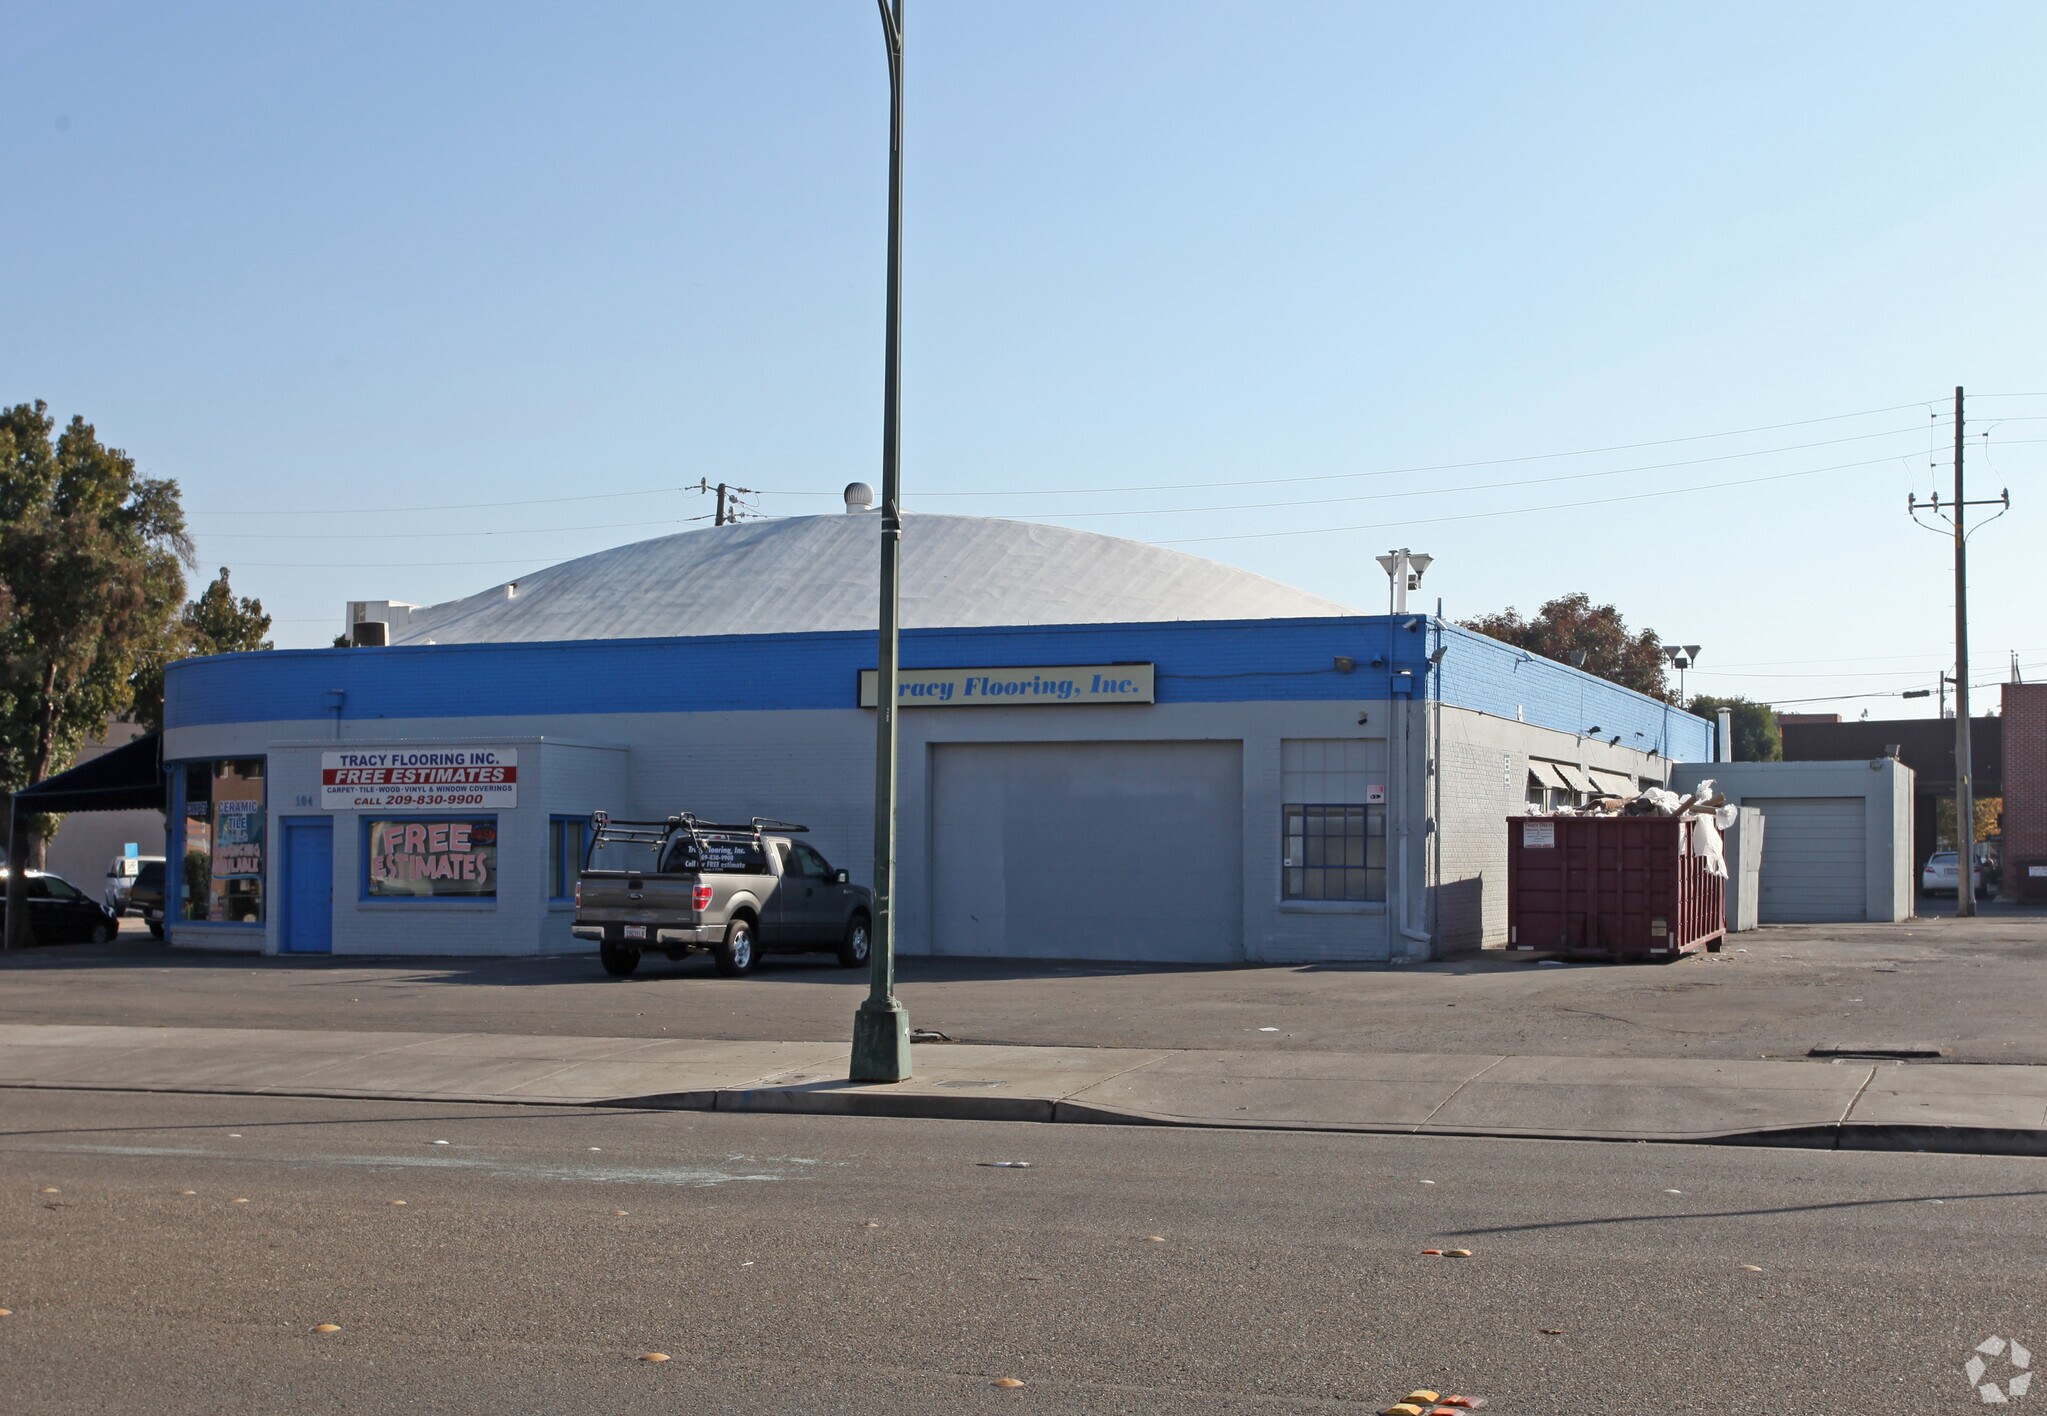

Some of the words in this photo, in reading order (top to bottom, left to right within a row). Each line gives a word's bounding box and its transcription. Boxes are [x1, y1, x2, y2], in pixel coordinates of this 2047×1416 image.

[898, 679, 954, 701] racy
[963, 675, 1081, 700] Flooring,
[1090, 674, 1139, 694] Inc.
[340, 755, 387, 766] TRACY
[392, 753, 465, 766] FLOORING
[470, 753, 499, 764] INC.
[335, 769, 387, 784] FREE
[391, 768, 505, 783] ESTIMATES
[386, 794, 483, 805] 209-830-9900
[218, 800, 259, 814] CERAMIC
[228, 816, 247, 830] TILE
[383, 823, 472, 855] FREE
[707, 846, 733, 854] looring,
[734, 846, 745, 854] Inc.
[371, 852, 488, 885] ESTIMATES
